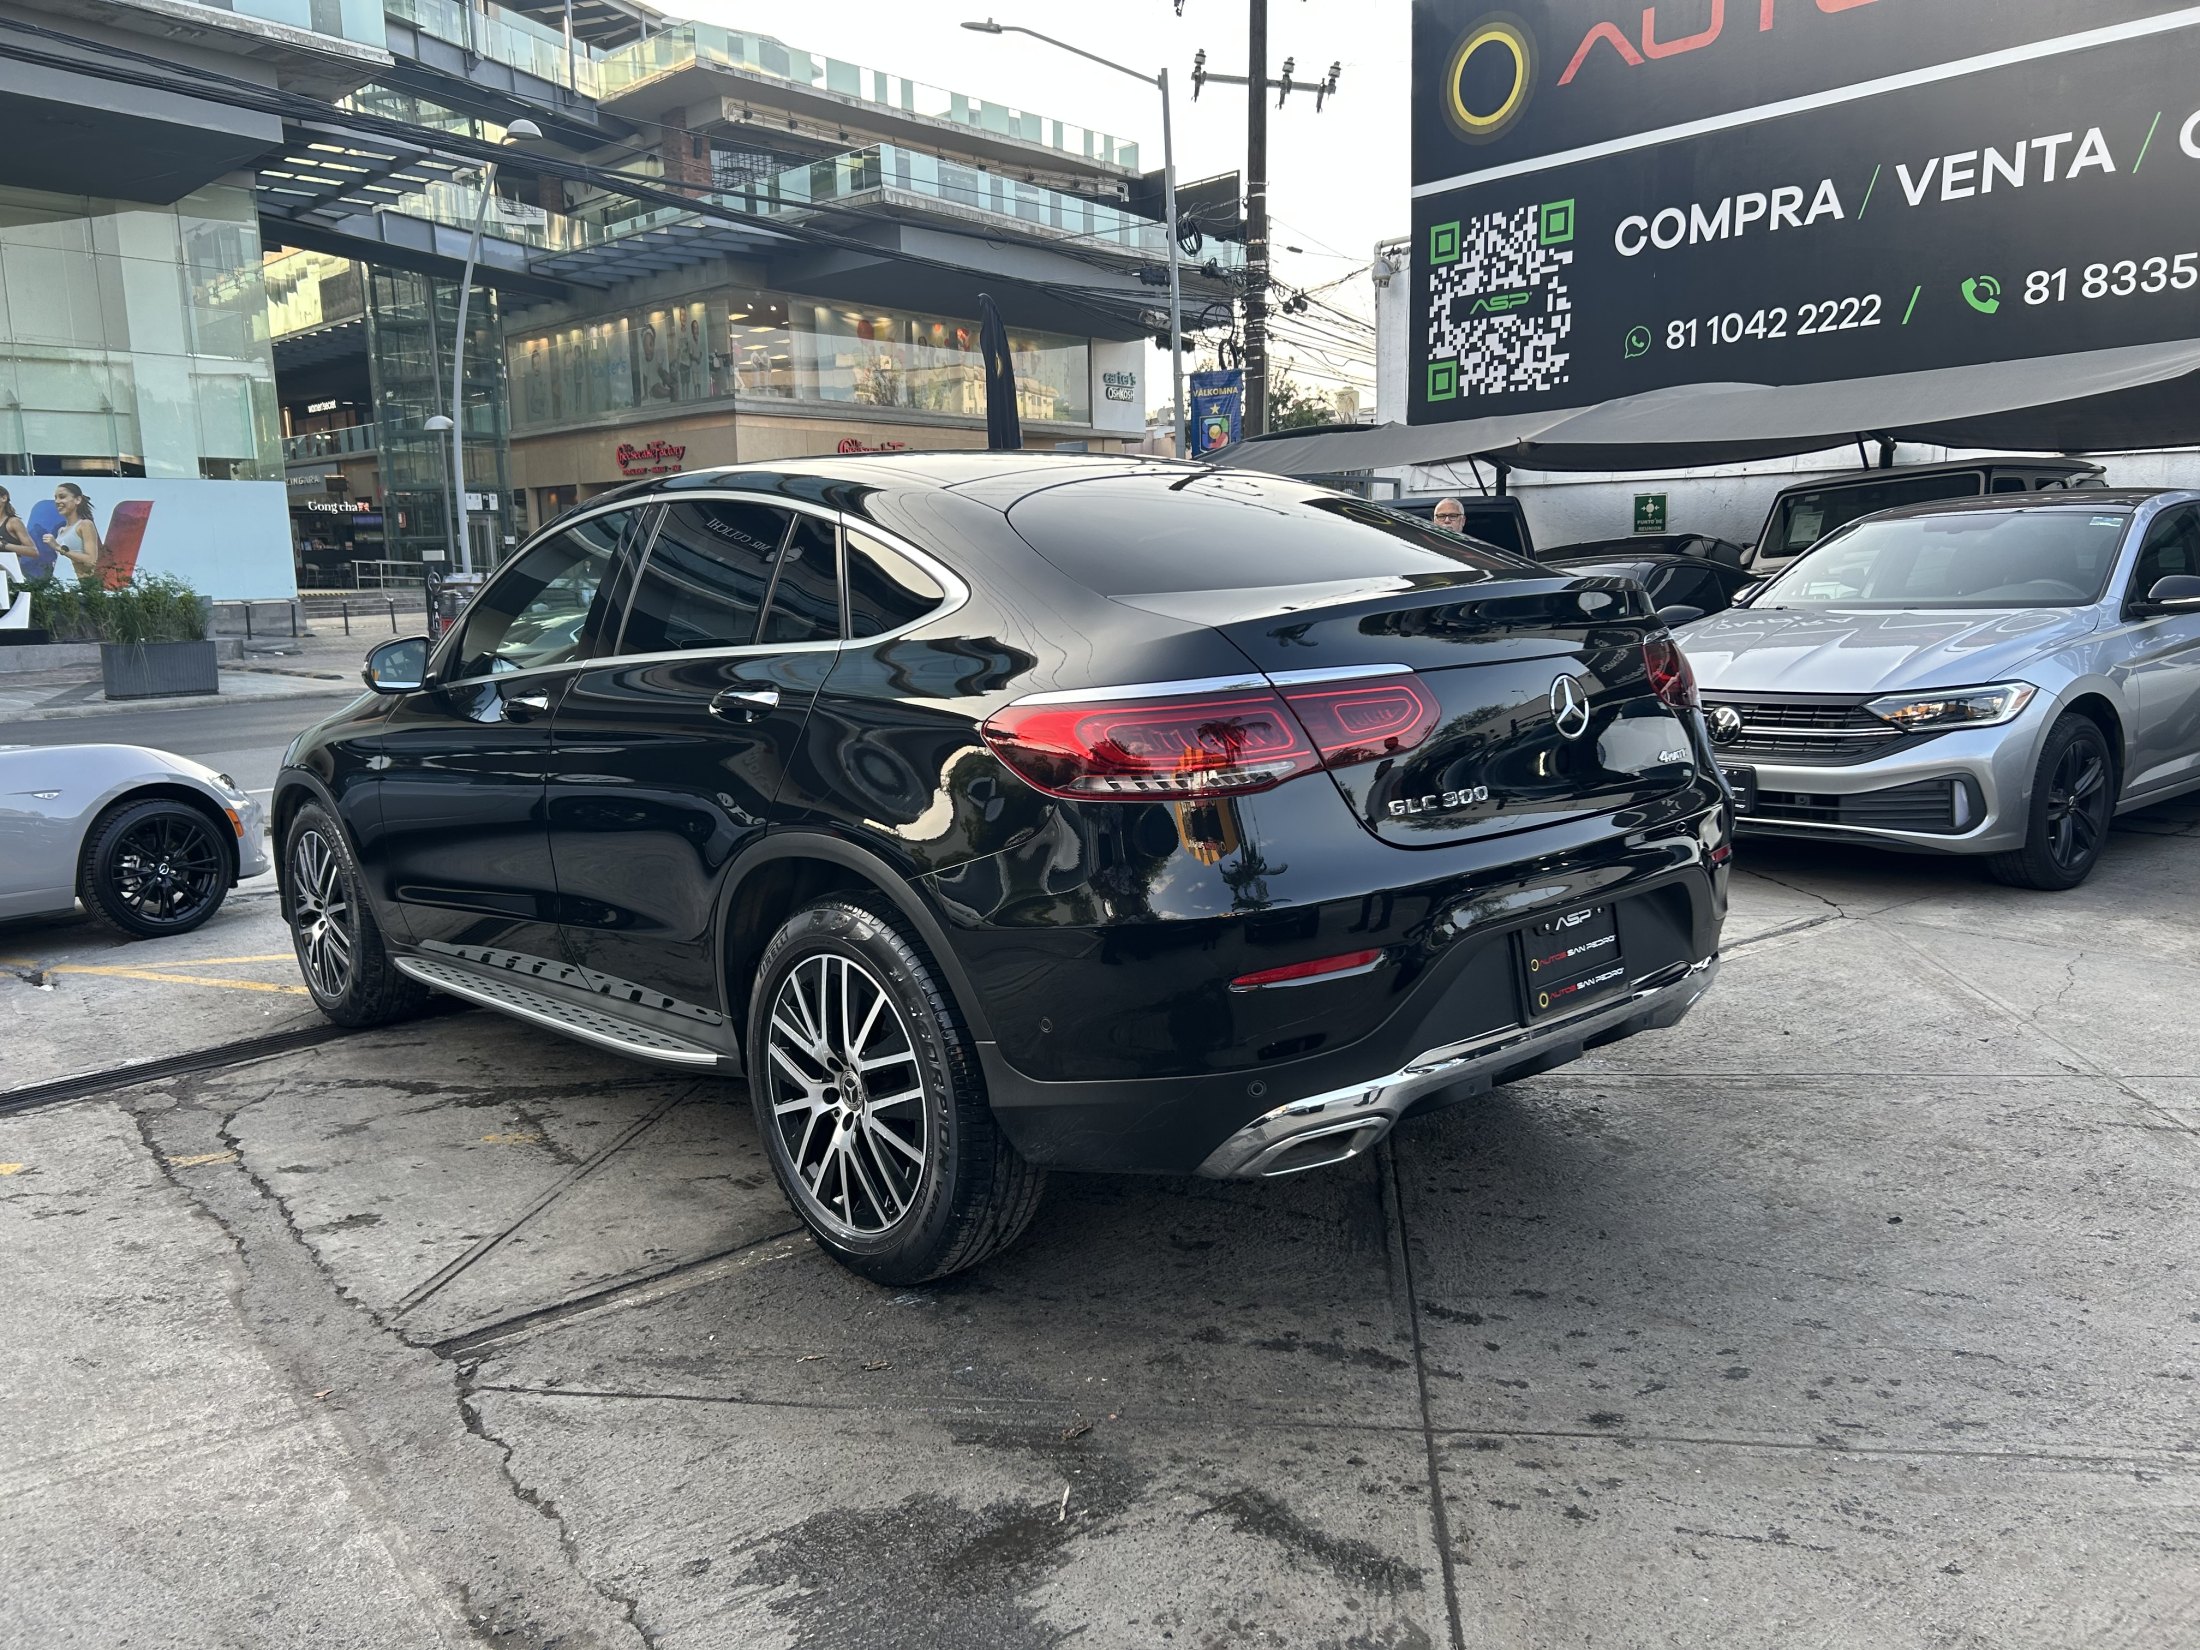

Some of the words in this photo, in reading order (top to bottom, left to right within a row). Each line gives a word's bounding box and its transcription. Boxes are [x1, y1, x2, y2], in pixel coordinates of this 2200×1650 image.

[1614, 178, 1845, 257] COMPRA
[1895, 126, 2117, 207] VENTA
[1469, 292, 1532, 314] ASP
[1666, 318, 1697, 350] 81
[1706, 307, 1788, 345] 1042
[1797, 294, 1882, 336] 2222
[2023, 267, 2067, 305] 81
[2081, 252, 2199, 299] 8335
[308, 501, 339, 514] Gong
[340, 501, 358, 512] cha
[1387, 793, 1438, 816] GLC
[1442, 785, 1489, 808] 300
[1555, 908, 1593, 931] ASP
[1540, 951, 1567, 965] AUTOS
[1567, 945, 1586, 957] SAN
[1586, 934, 1616, 950] PEDRO
[1549, 984, 1577, 1000] AUTOS
[1577, 978, 1595, 989] SAN
[1595, 967, 1625, 982] PEDRO
